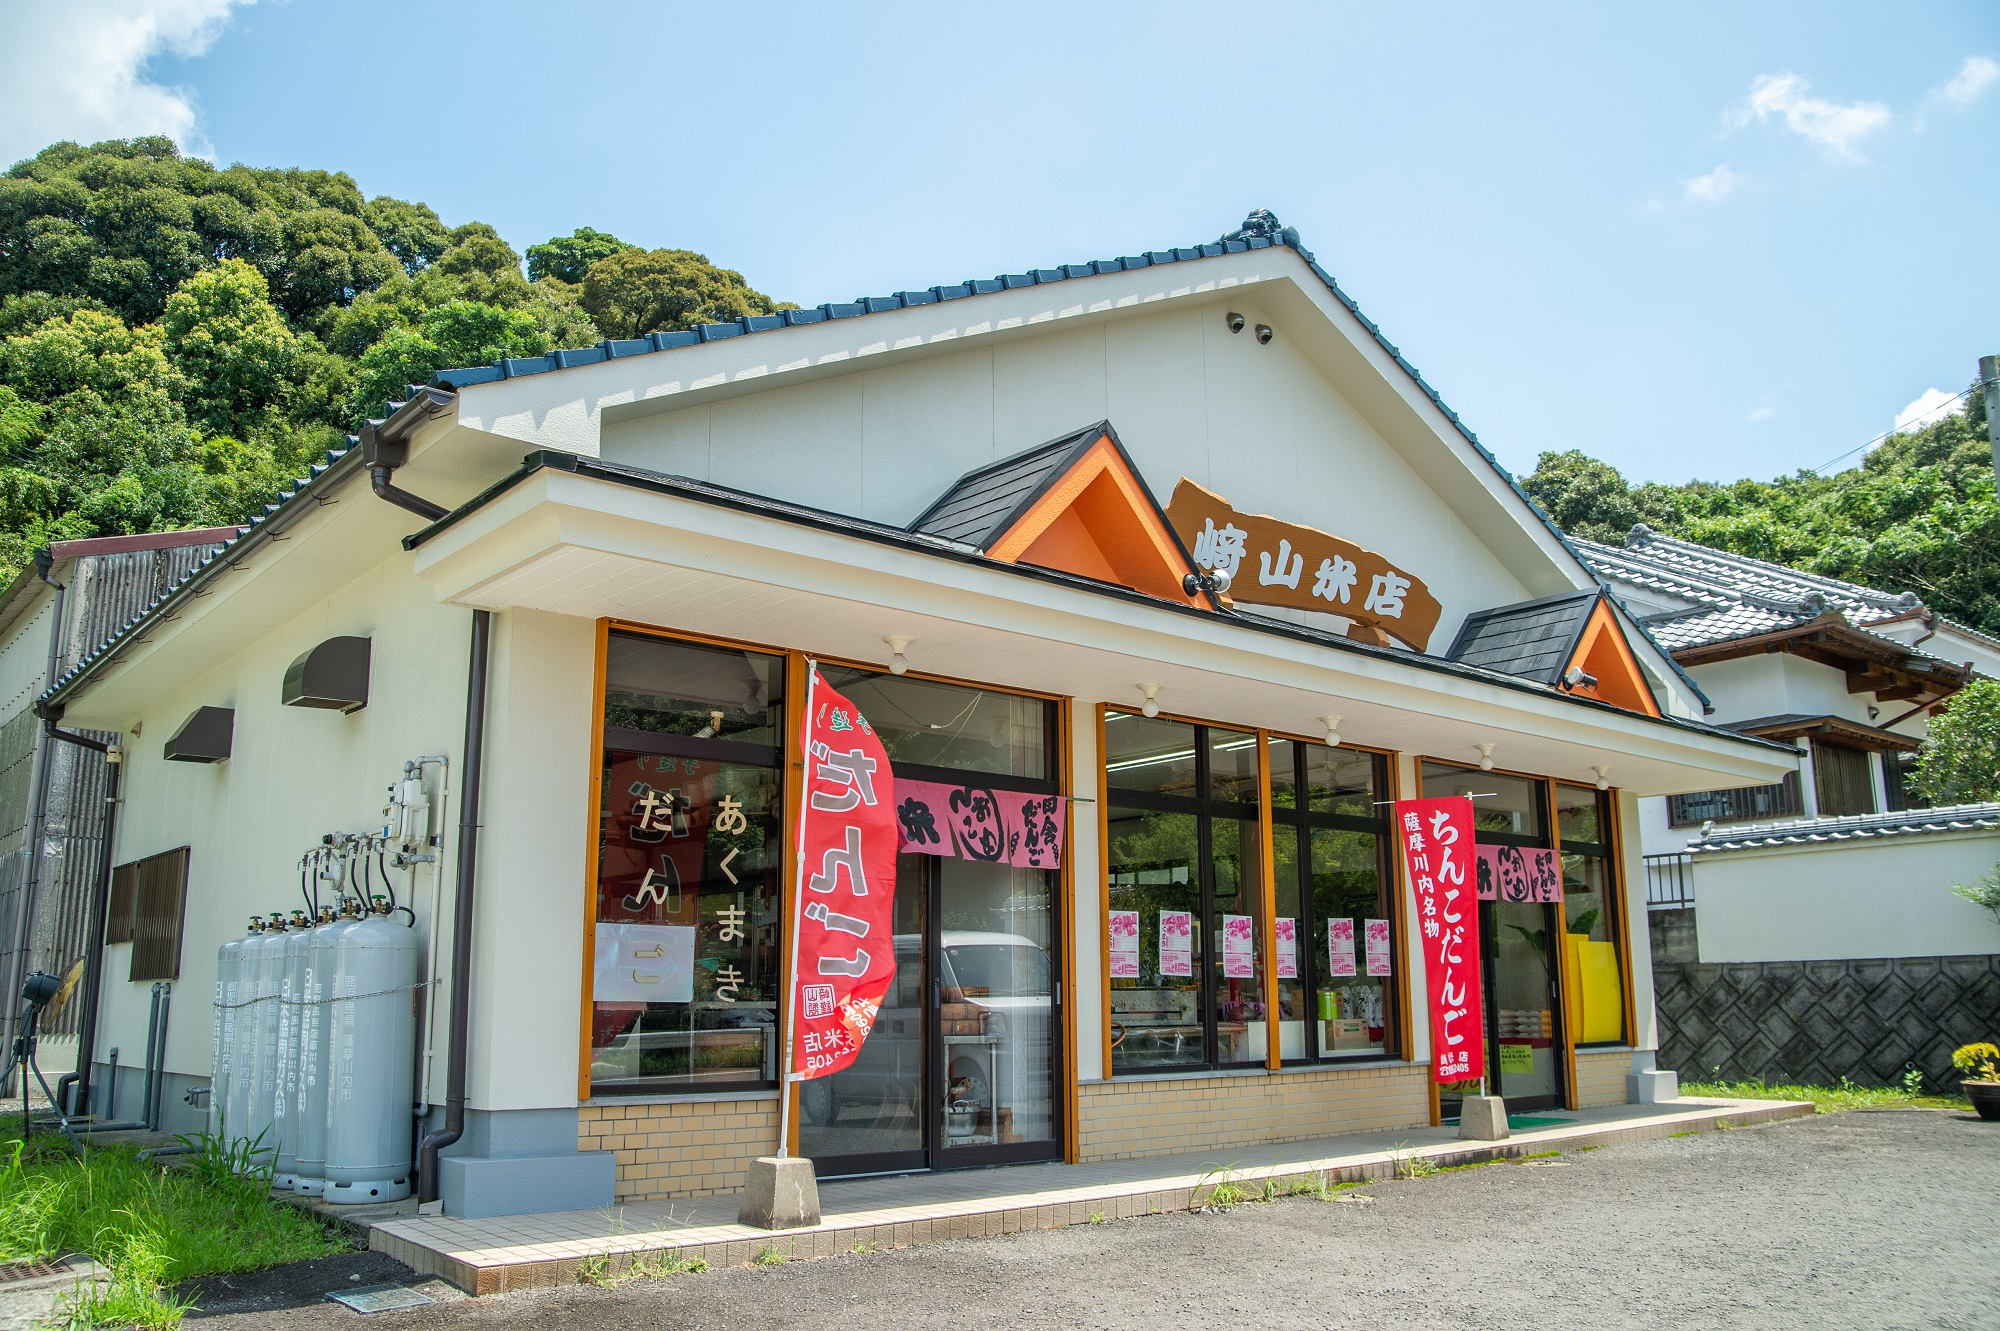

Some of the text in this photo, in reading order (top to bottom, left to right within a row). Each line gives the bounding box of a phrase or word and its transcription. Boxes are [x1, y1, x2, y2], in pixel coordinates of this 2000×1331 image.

[633, 790, 673, 984] だんご
[715, 794, 747, 1003] あくまき
[1403, 812, 1440, 939] 薩摩川内名物
[1428, 810, 1468, 1046] ちんこだんご
